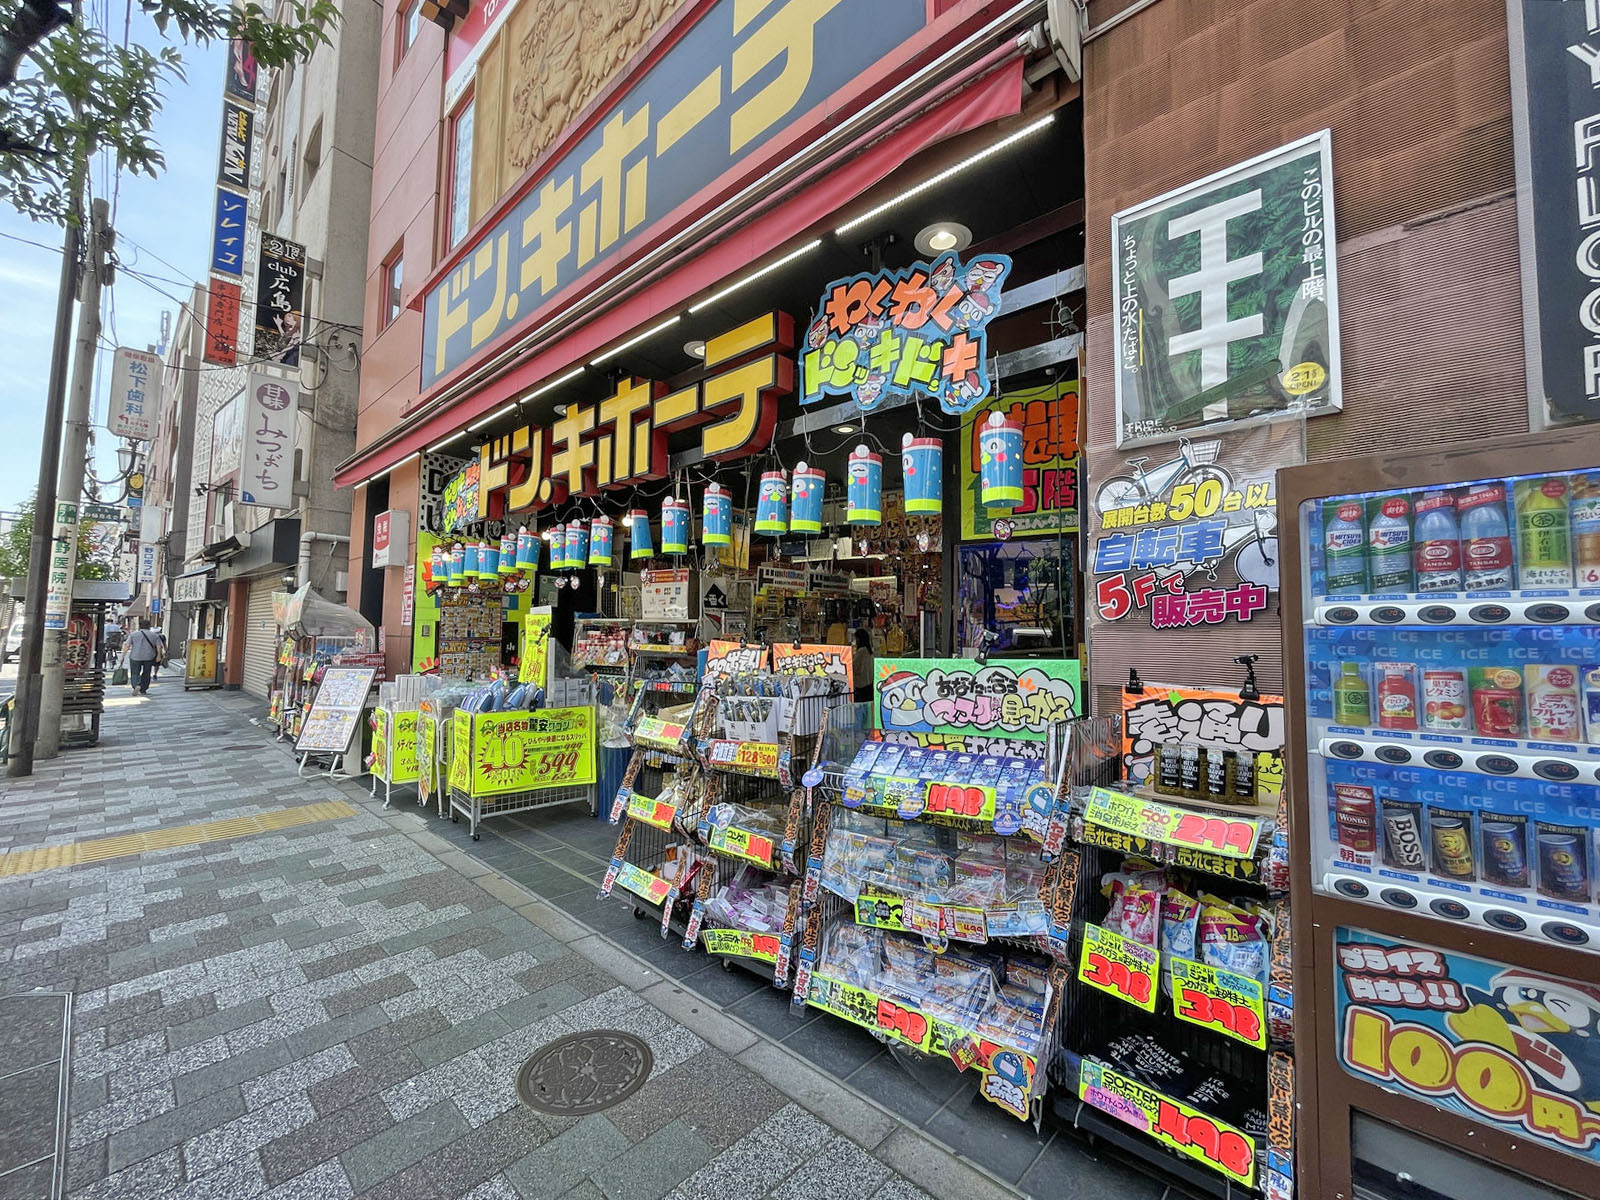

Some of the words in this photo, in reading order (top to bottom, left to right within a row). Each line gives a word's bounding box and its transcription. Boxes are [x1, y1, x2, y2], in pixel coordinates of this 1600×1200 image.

[218, 199, 242, 265] ソレイユ
[269, 240, 300, 260] 2F
[267, 262, 297, 278] club
[269, 274, 291, 312] 広島
[125, 361, 148, 416] 松下歯科
[255, 412, 288, 490] みつばち
[1101, 479, 1276, 530] 展開台数50台以
[1093, 520, 1228, 574] 自転車
[1152, 583, 1269, 629] 販売中
[483, 735, 524, 769] 40
[538, 751, 580, 776] 599
[1109, 801, 1137, 817] ホワイト
[1141, 808, 1172, 825] 500
[1338, 813, 1368, 825] WONDA
[1084, 822, 1134, 851] 売れてます
[1173, 814, 1254, 854] 299
[1395, 817, 1423, 866] BOSS
[1178, 847, 1242, 879] 売れてます
[1085, 953, 1152, 1004] 398
[1339, 946, 1442, 975] プライス
[877, 998, 928, 1044] 598
[1180, 988, 1261, 1042] 398
[1103, 1071, 1160, 1107] SOFTER
[1156, 1100, 1253, 1177] 498
